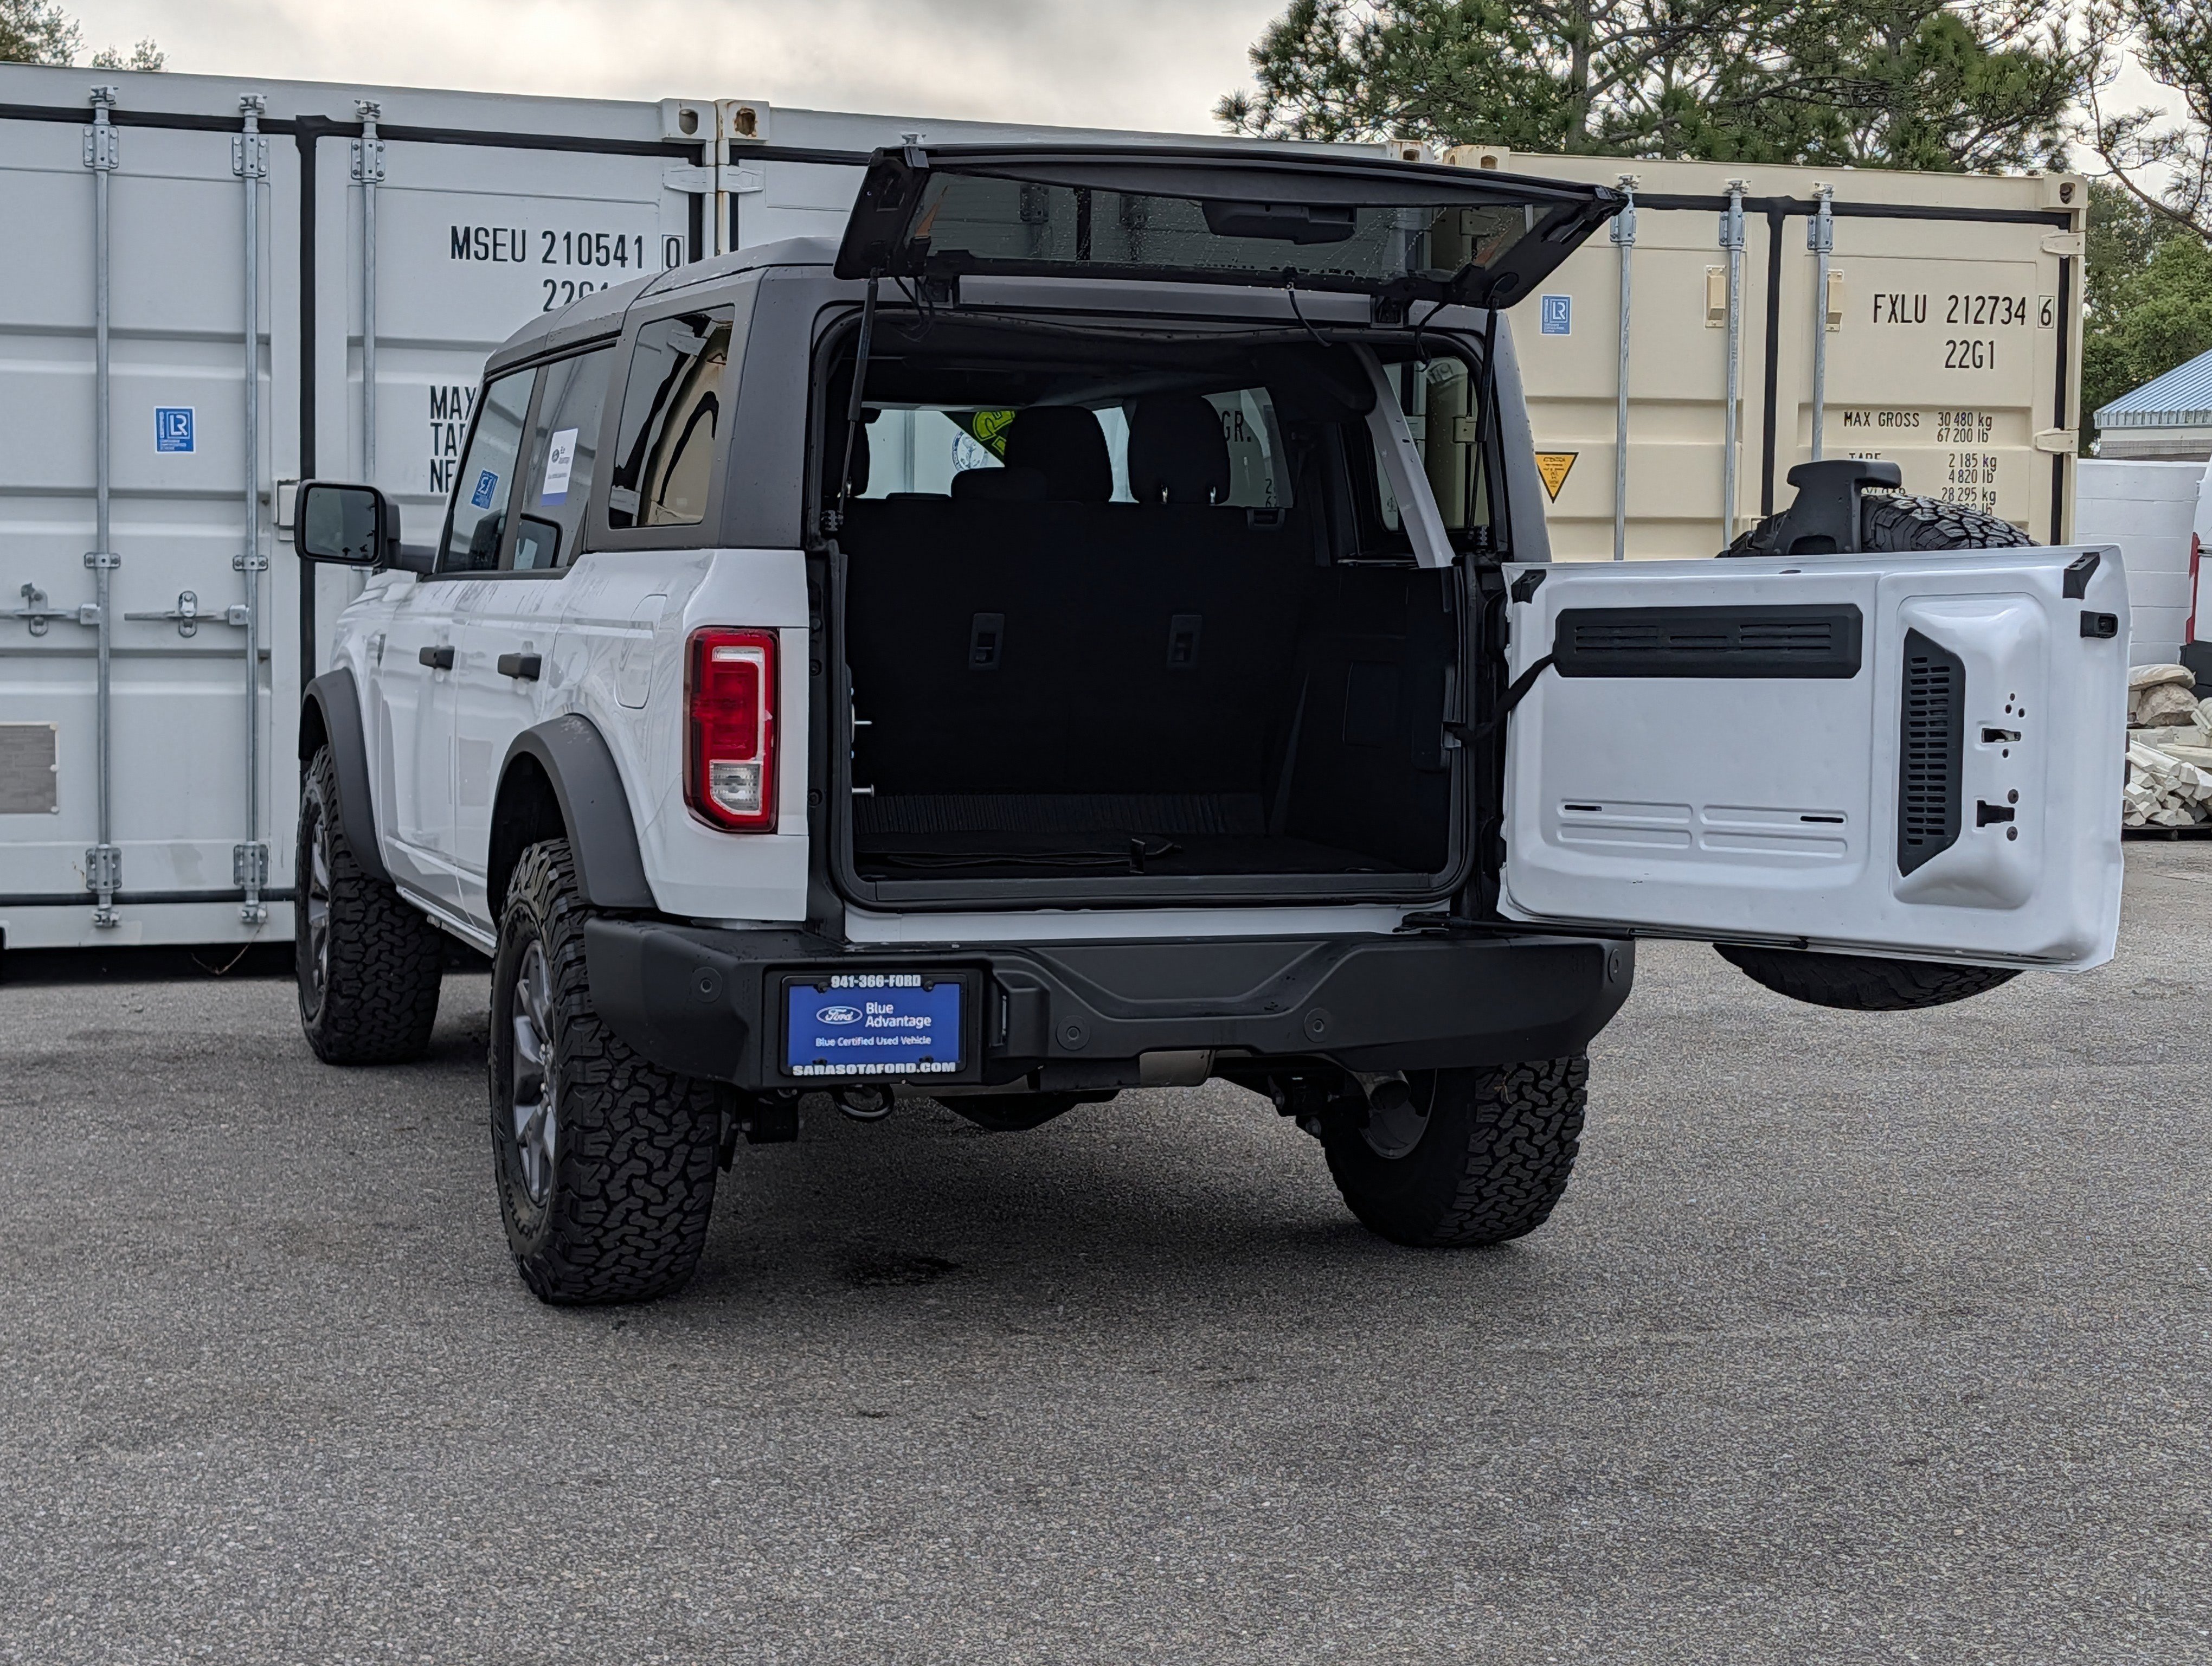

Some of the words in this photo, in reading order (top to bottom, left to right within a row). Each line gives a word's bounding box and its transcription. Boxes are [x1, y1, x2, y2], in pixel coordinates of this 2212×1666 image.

[451, 226, 526, 262] MSEU
[542, 230, 642, 268] 210541
[1873, 294, 1927, 323] FXLU
[1946, 294, 2026, 325] 212734
[2041, 298, 2052, 326] 6
[1945, 339, 1994, 369] 22G1
[1844, 412, 1871, 427] MAX
[1878, 412, 1920, 427] GROSS
[1978, 412, 1992, 431] kg
[1977, 428, 1989, 443] lb
[1983, 453, 1997, 472] kg
[1982, 469, 1994, 483] lb
[1982, 486, 1996, 505] kg
[831, 975, 921, 988] 941-366-FORD
[866, 1002, 894, 1014] Blue
[865, 1015, 931, 1029] Advantage
[815, 1037, 836, 1047] Blue
[837, 1036, 874, 1046] Certified
[876, 1036, 899, 1045] Used
[901, 1036, 931, 1045] Vehicle
[793, 1062, 956, 1075] SARASOTAFORD.COM
